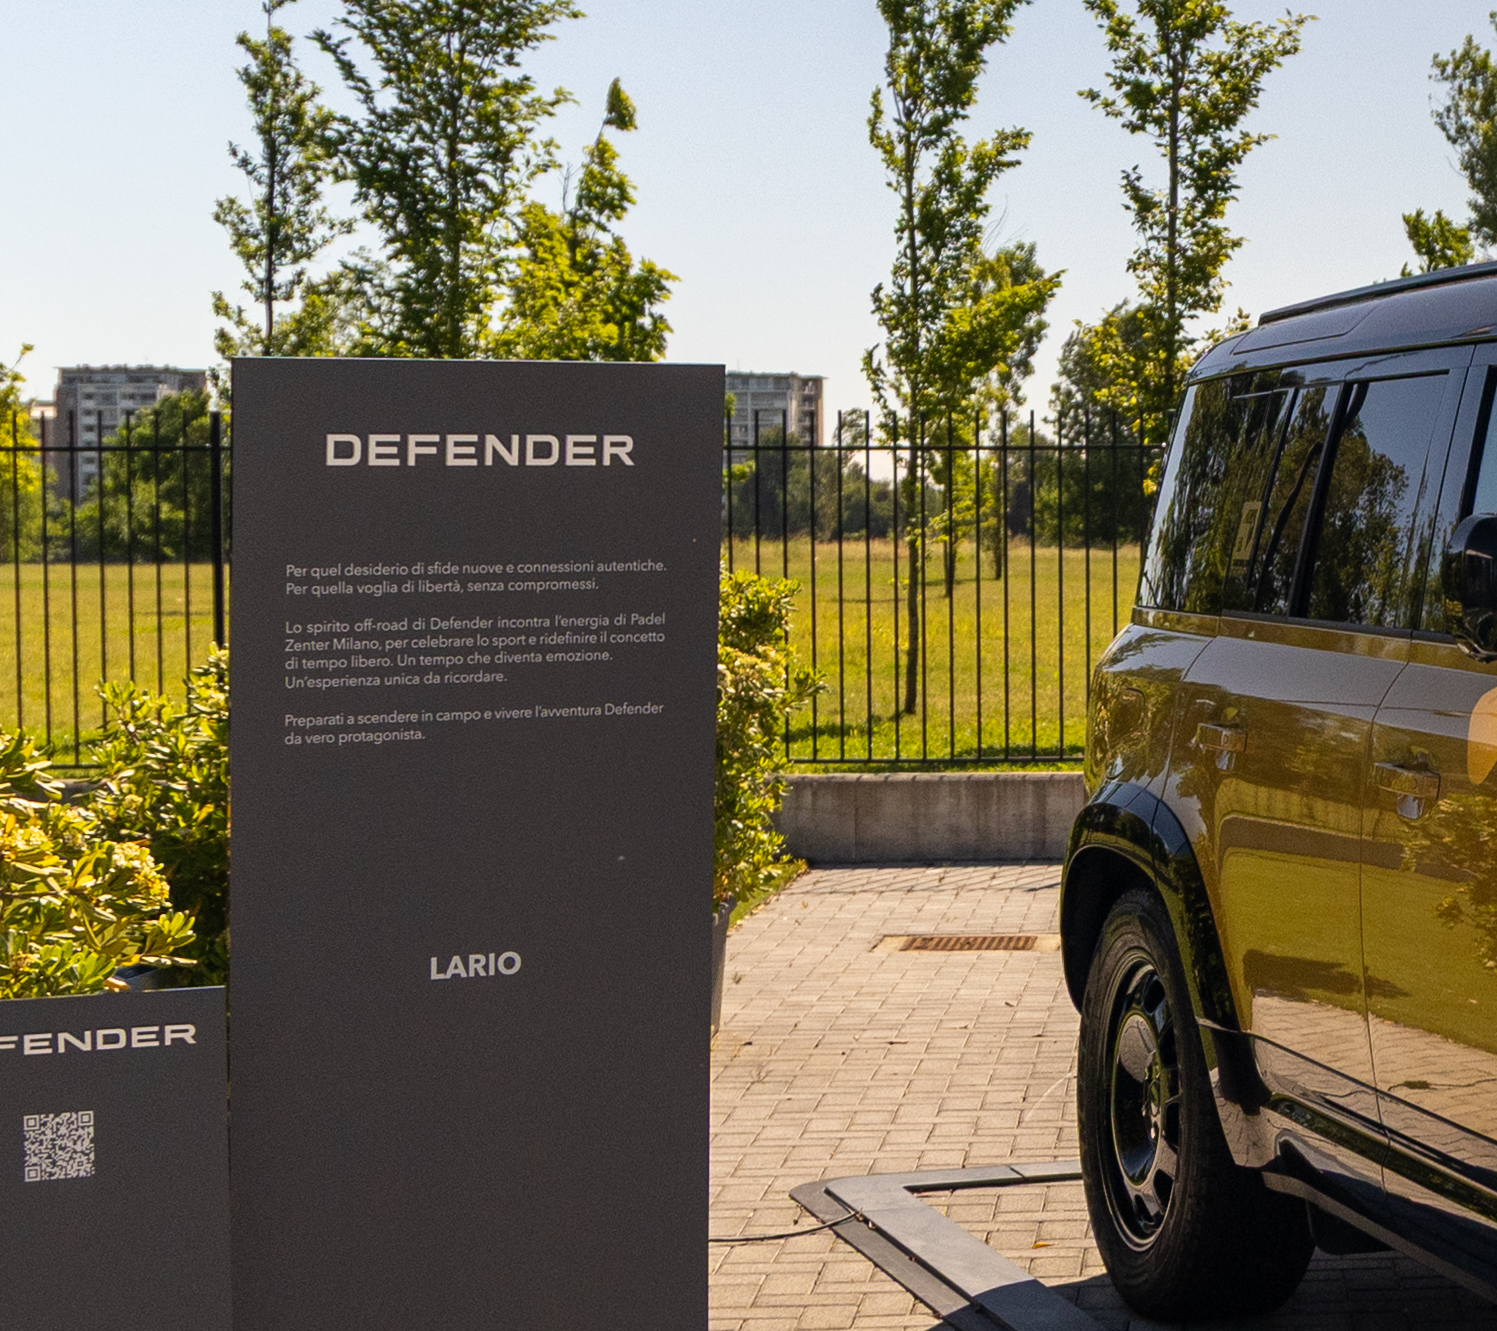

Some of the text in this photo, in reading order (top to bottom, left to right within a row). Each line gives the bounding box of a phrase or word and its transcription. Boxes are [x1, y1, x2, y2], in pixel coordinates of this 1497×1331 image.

[325, 433, 636, 467] DEFENDER
[285, 558, 668, 580] Per quel desiderio di sfide nuove e connessioni autentiche.
[285, 577, 600, 598] Per quella voglia di libertà, senza compromessi.
[285, 620, 303, 635] Lo
[306, 619, 351, 637] spirito
[353, 618, 408, 633] off-road
[411, 617, 426, 631] di
[429, 616, 494, 631] Defender
[497, 616, 551, 629] incontra
[613, 613, 627, 626] di
[630, 612, 666, 626] Padel
[284, 631, 666, 653] Zenter Milano, per celebrare lo sport e ridefinire il concetto
[284, 649, 614, 672] di tempo libero. Un tempo che diventa emozione.
[383, 672, 420, 686] unica
[423, 671, 441, 685] da
[443, 669, 508, 684] ricordare.
[284, 712, 345, 730] Preparati
[346, 715, 355, 725] a
[357, 709, 419, 725] scendere
[421, 709, 434, 722] in
[435, 710, 481, 724] campo
[483, 710, 493, 720] e
[494, 707, 533, 720] vivere
[603, 701, 665, 716] Defender
[284, 728, 426, 746] da vero protagonista.
[430, 951, 522, 980] LARIO
